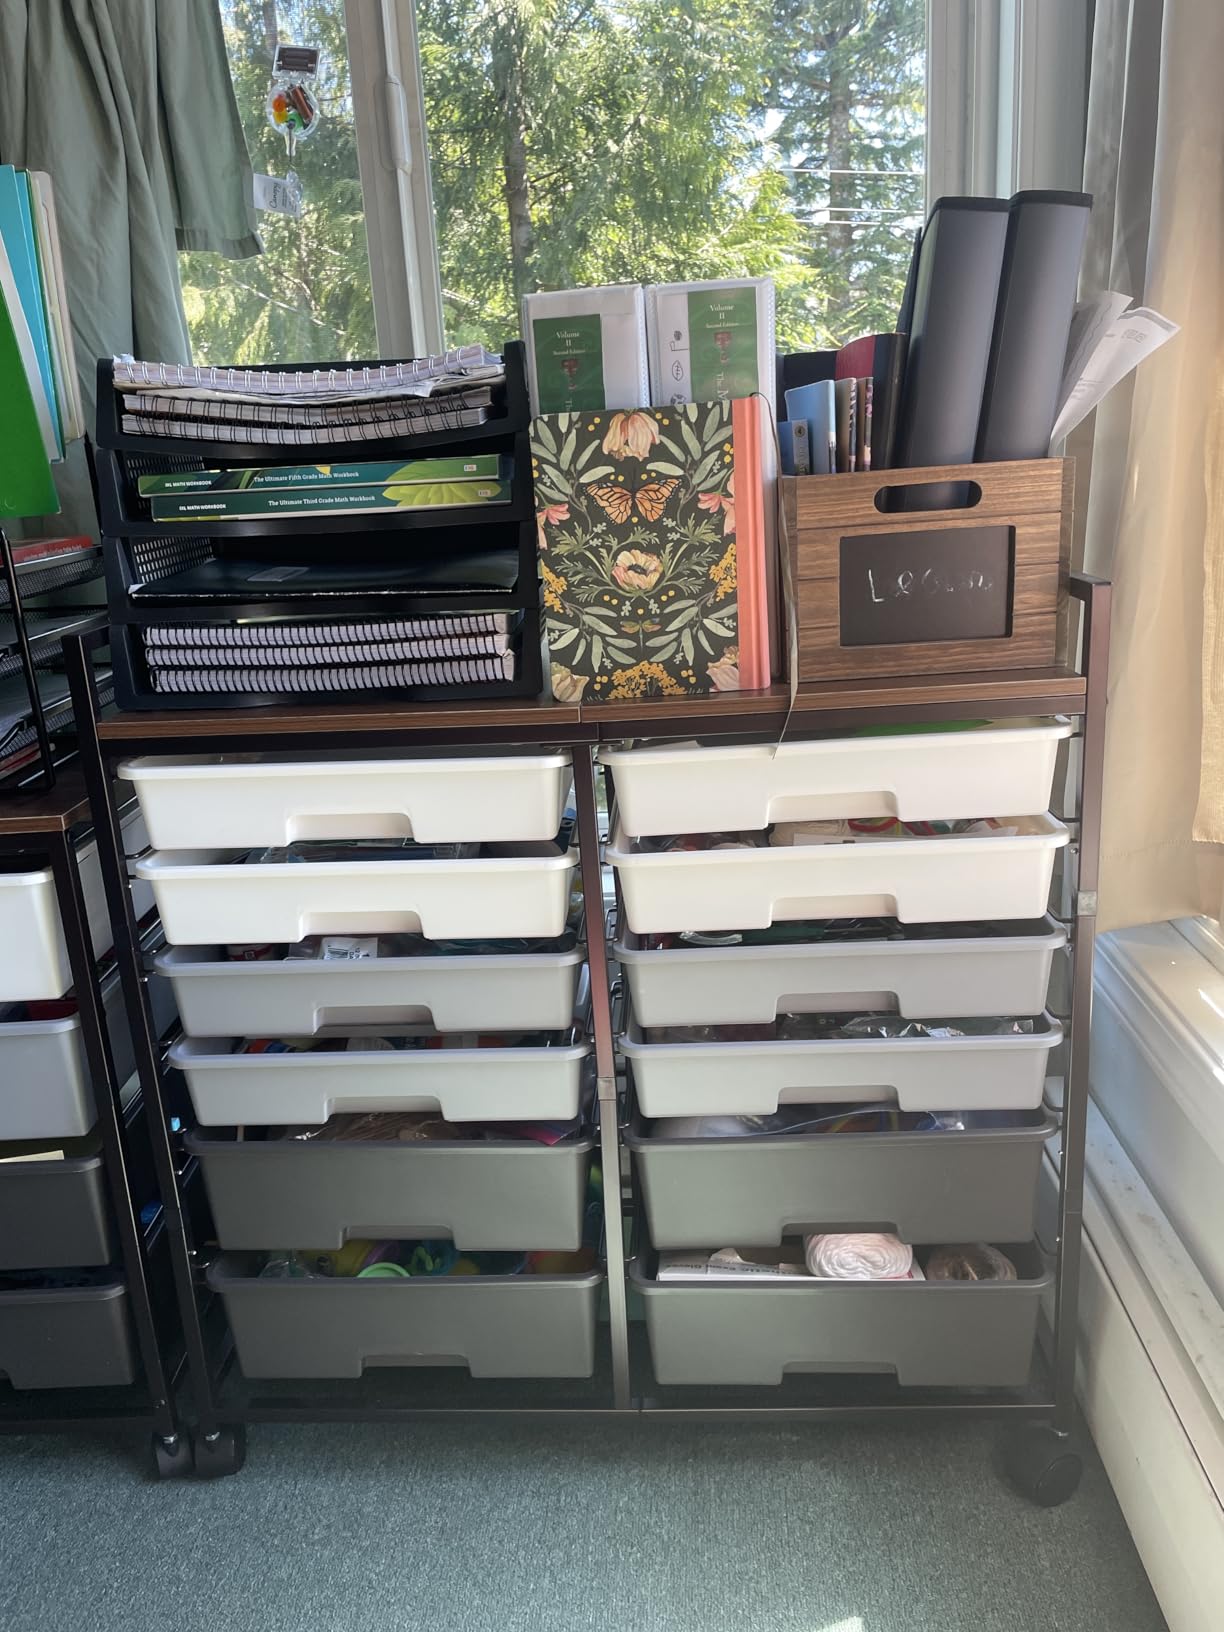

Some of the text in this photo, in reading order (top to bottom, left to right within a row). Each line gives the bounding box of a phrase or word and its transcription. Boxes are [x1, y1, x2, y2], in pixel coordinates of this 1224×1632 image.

[719, 312, 725, 320] II
[556, 331, 580, 339] Volume
[566, 339, 572, 347] II
